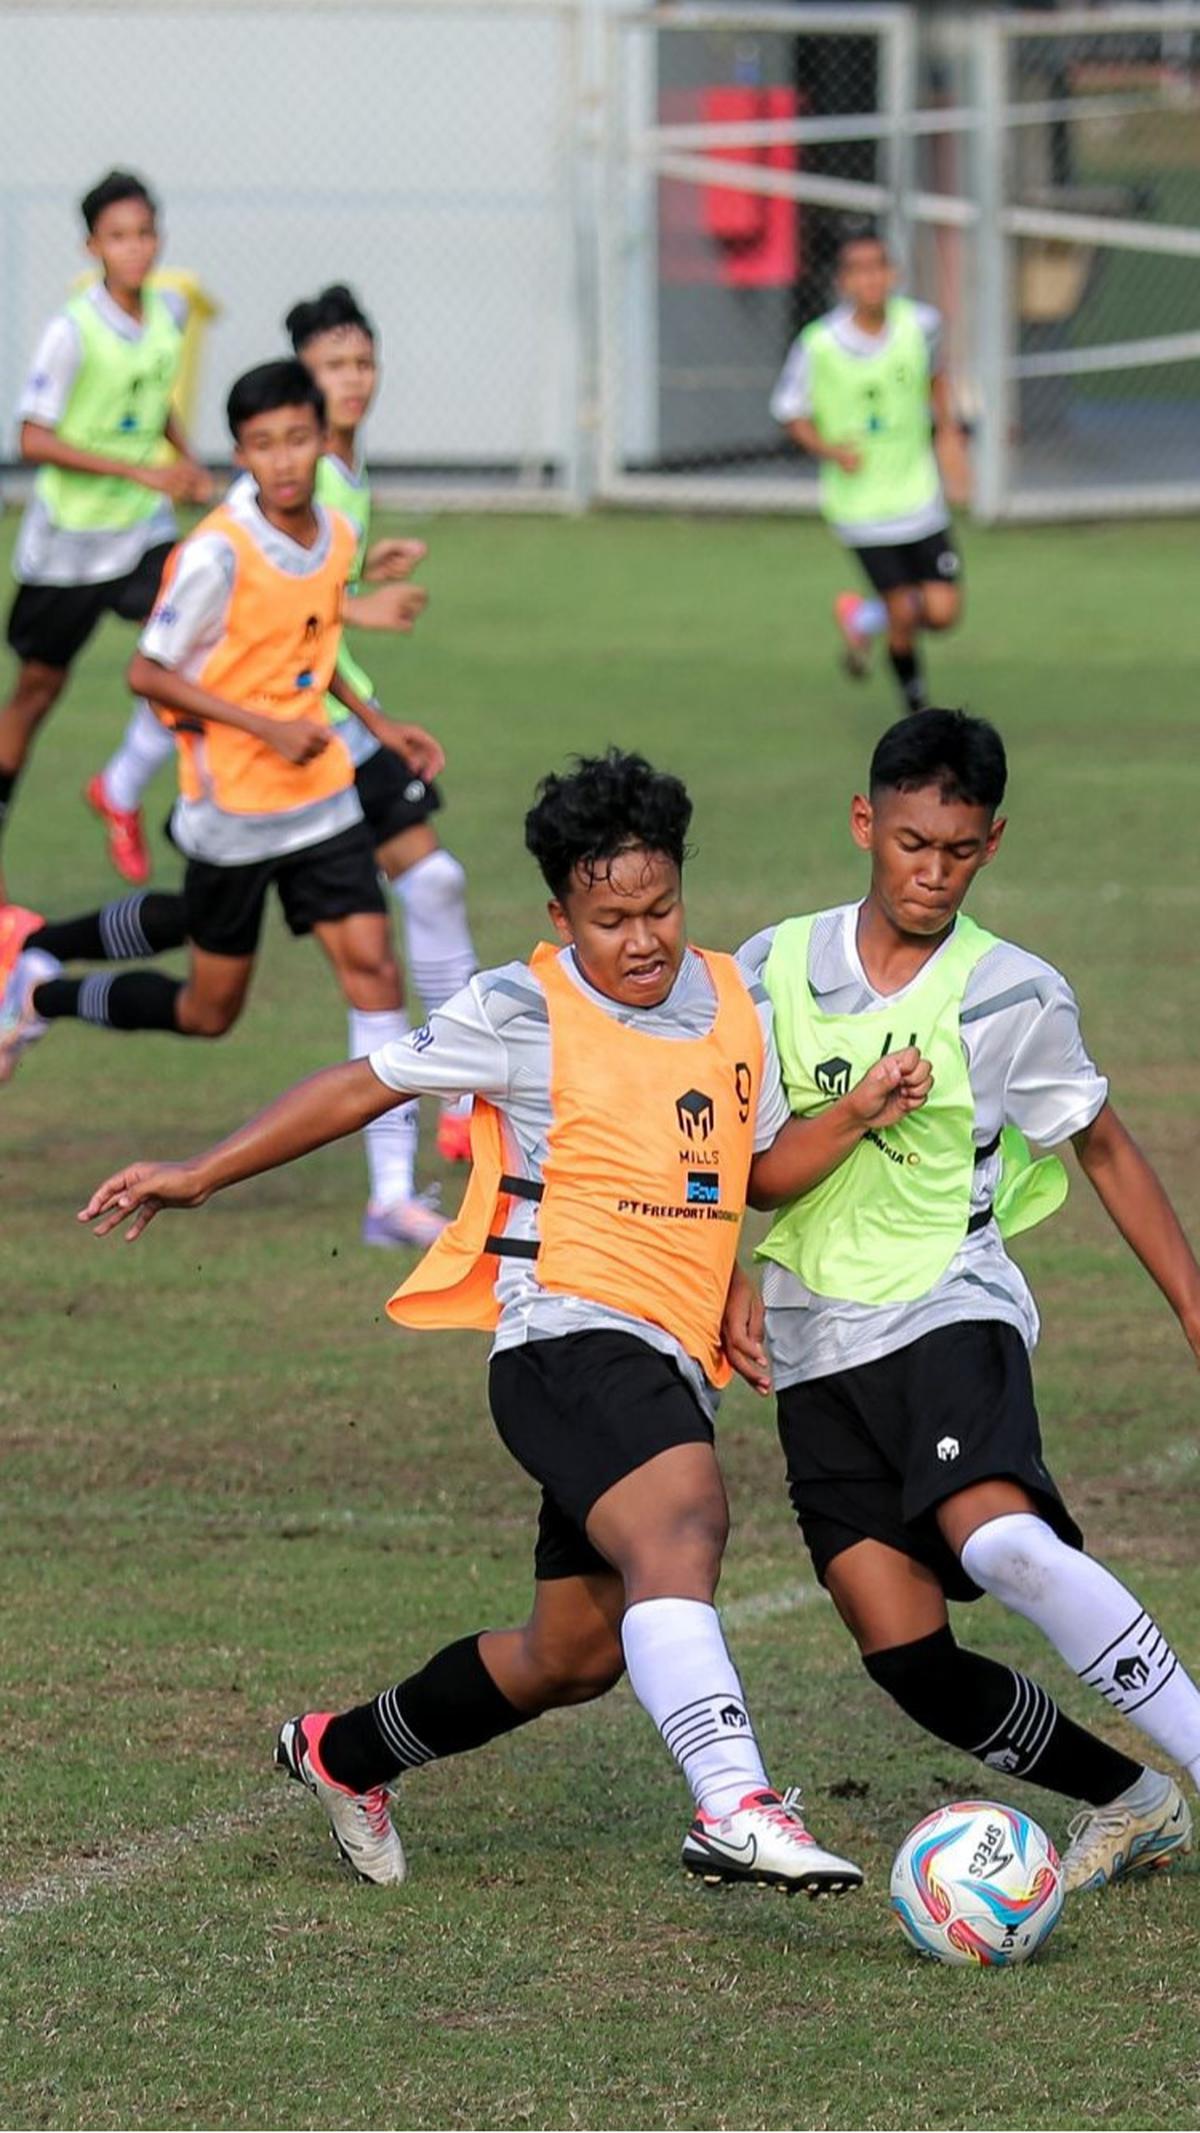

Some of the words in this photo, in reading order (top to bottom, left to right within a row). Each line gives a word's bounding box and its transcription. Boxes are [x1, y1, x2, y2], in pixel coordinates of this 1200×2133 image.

[735, 1062, 752, 1124] 9
[679, 1150, 719, 1164] MILLS
[618, 1200, 639, 1214] PT
[642, 1203, 704, 1219] FREEPORT
[968, 1824, 1002, 1878] SPECS
